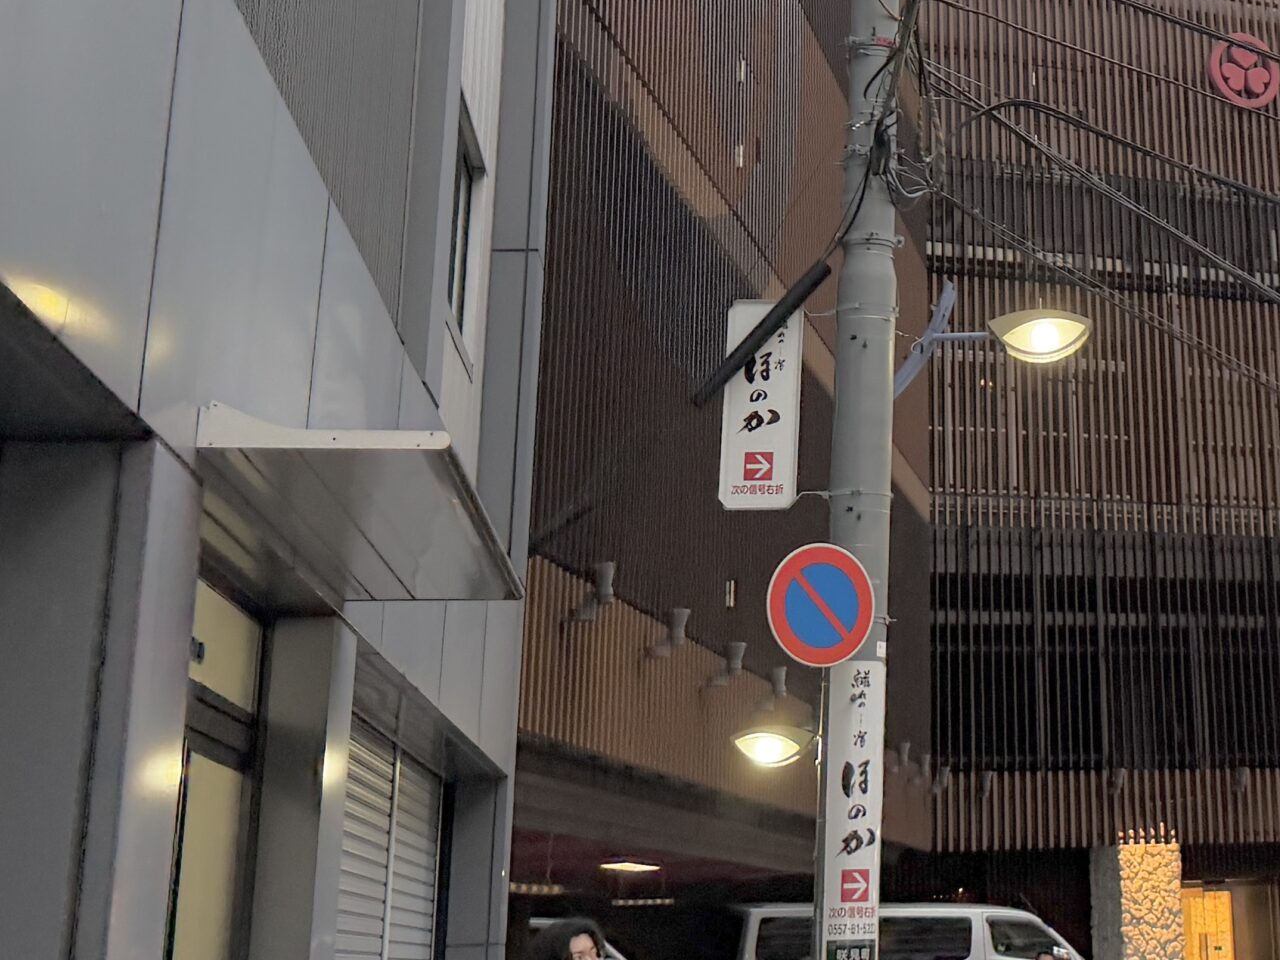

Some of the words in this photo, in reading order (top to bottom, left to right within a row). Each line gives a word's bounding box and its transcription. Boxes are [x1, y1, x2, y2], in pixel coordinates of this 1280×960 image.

[736, 350, 781, 435] ほのか
[731, 484, 784, 495] 次の信号右折
[835, 759, 876, 858] ほのか
